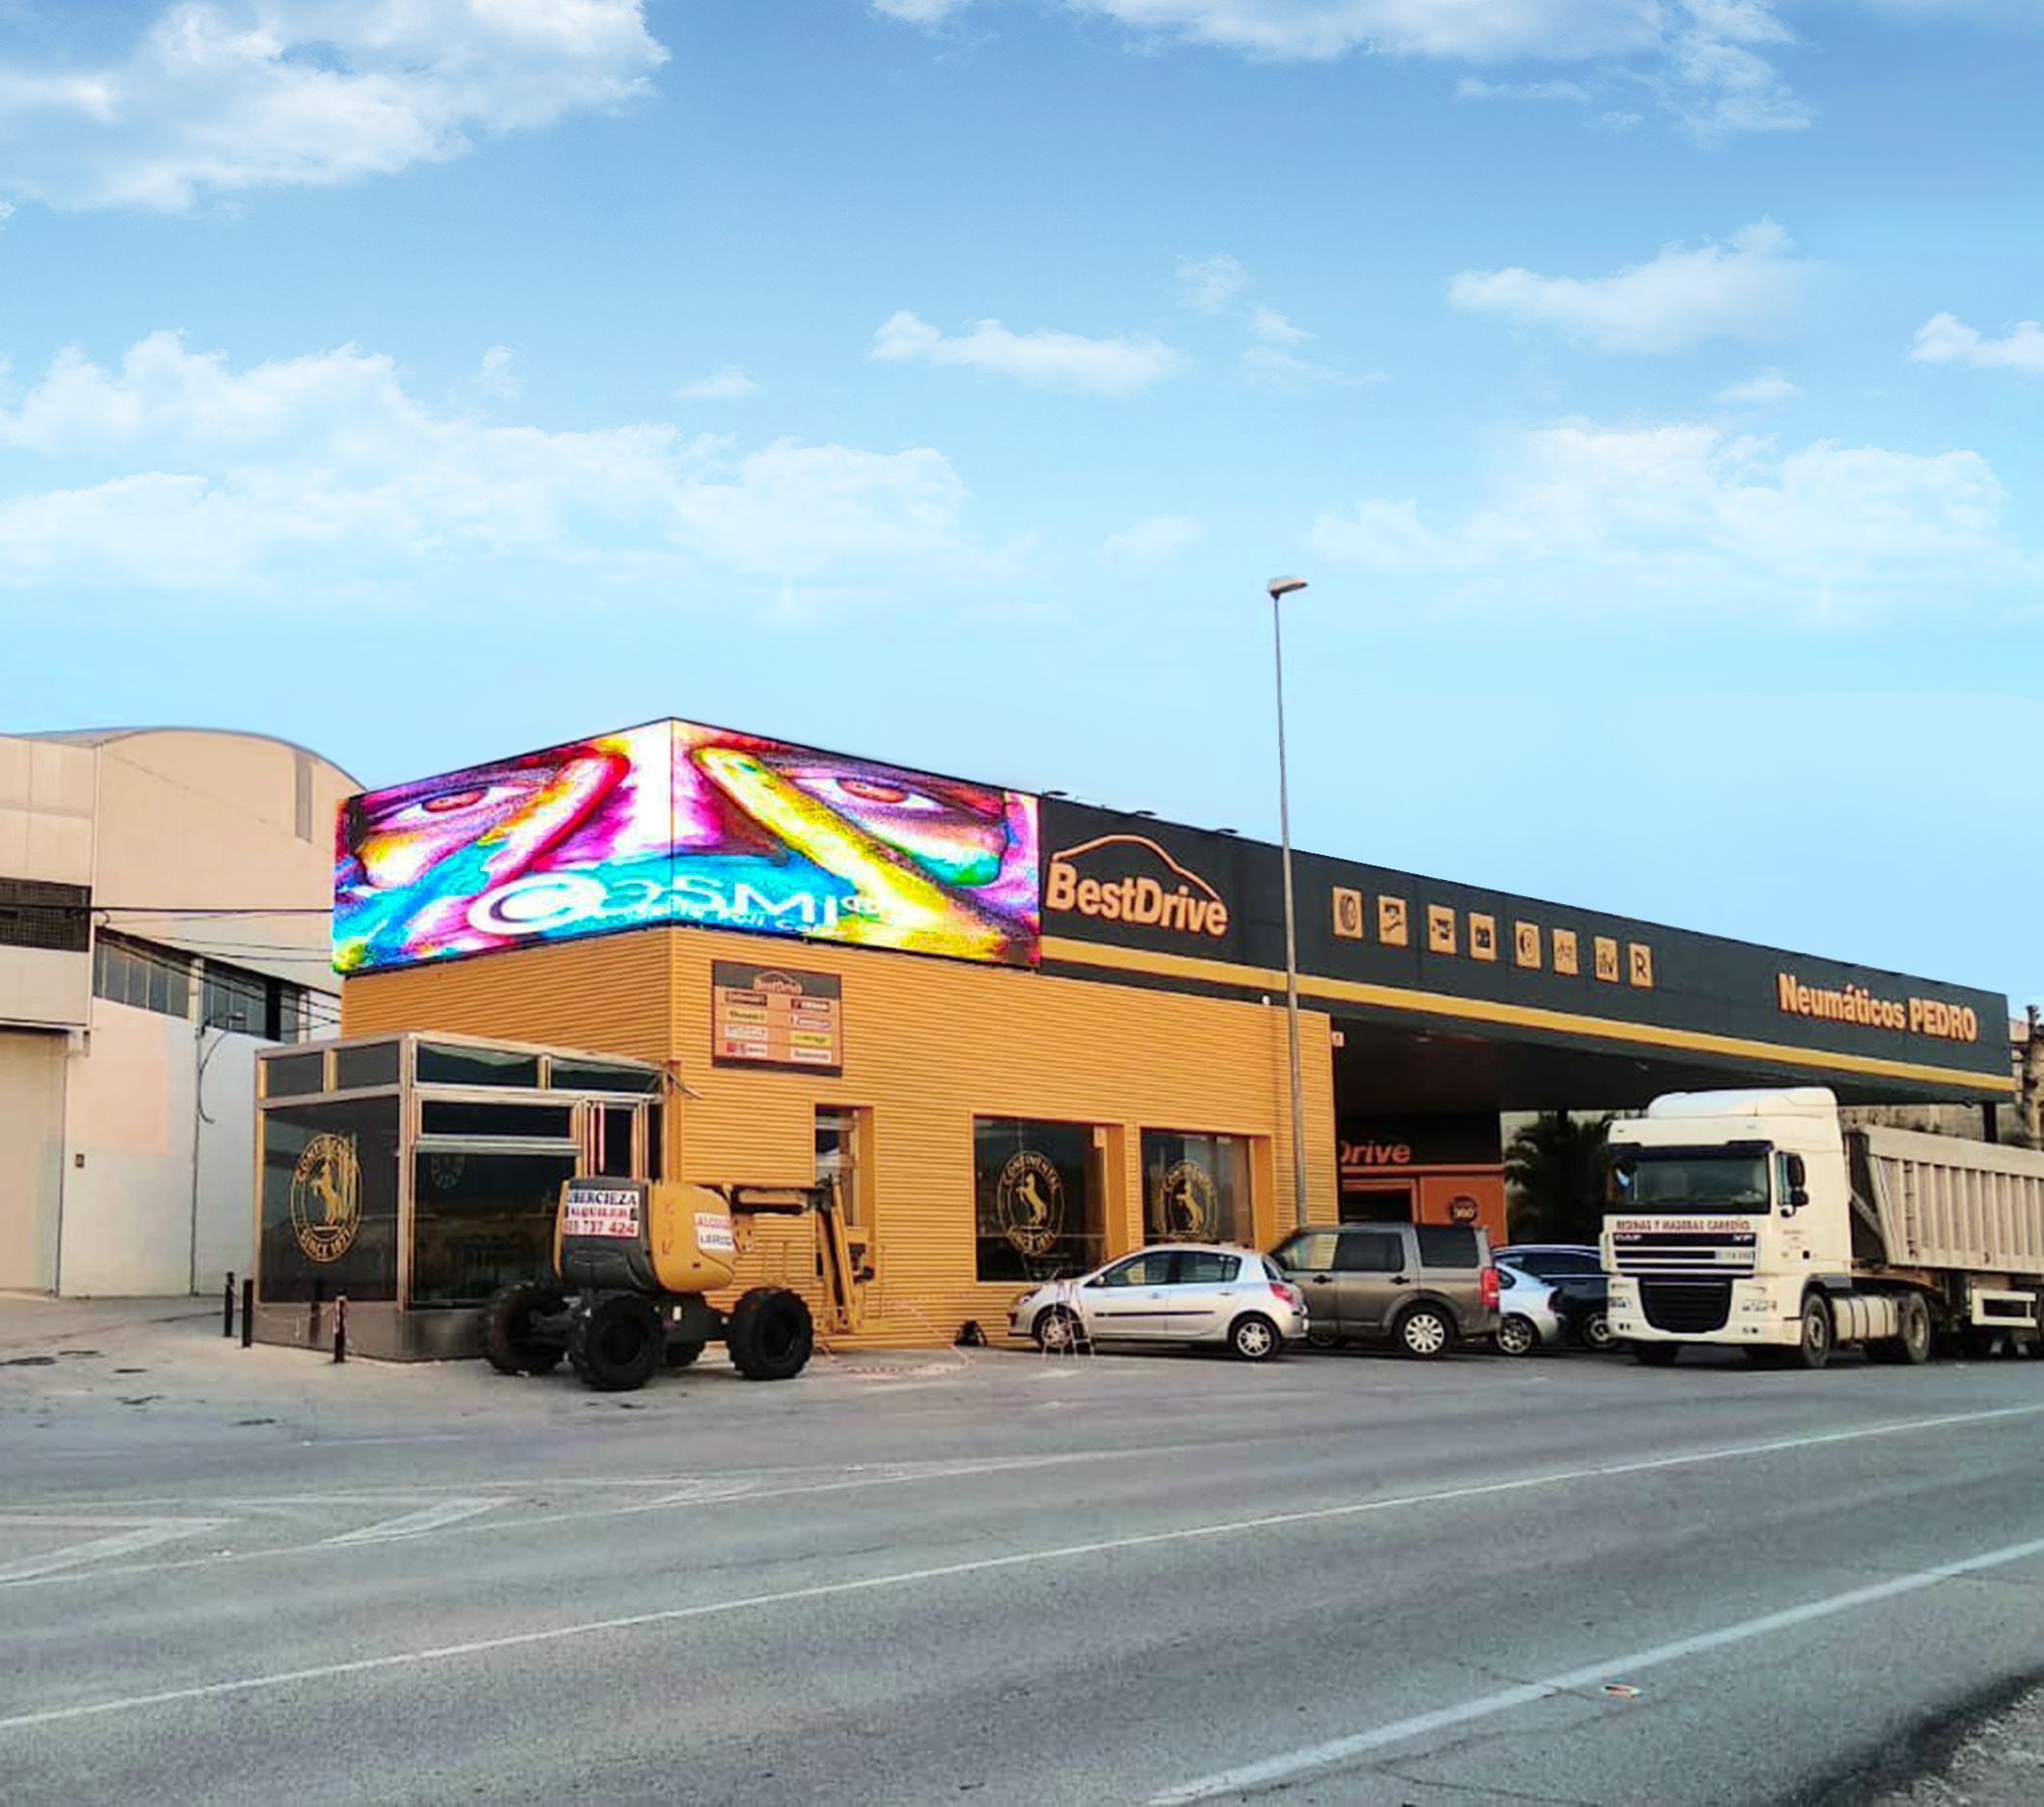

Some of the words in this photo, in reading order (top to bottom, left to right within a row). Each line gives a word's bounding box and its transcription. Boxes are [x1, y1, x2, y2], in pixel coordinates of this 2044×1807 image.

[1046, 862, 1229, 937] BestDrive
[1778, 972, 1905, 1029] Neumáticos
[1908, 997, 1978, 1042] PEDRO
